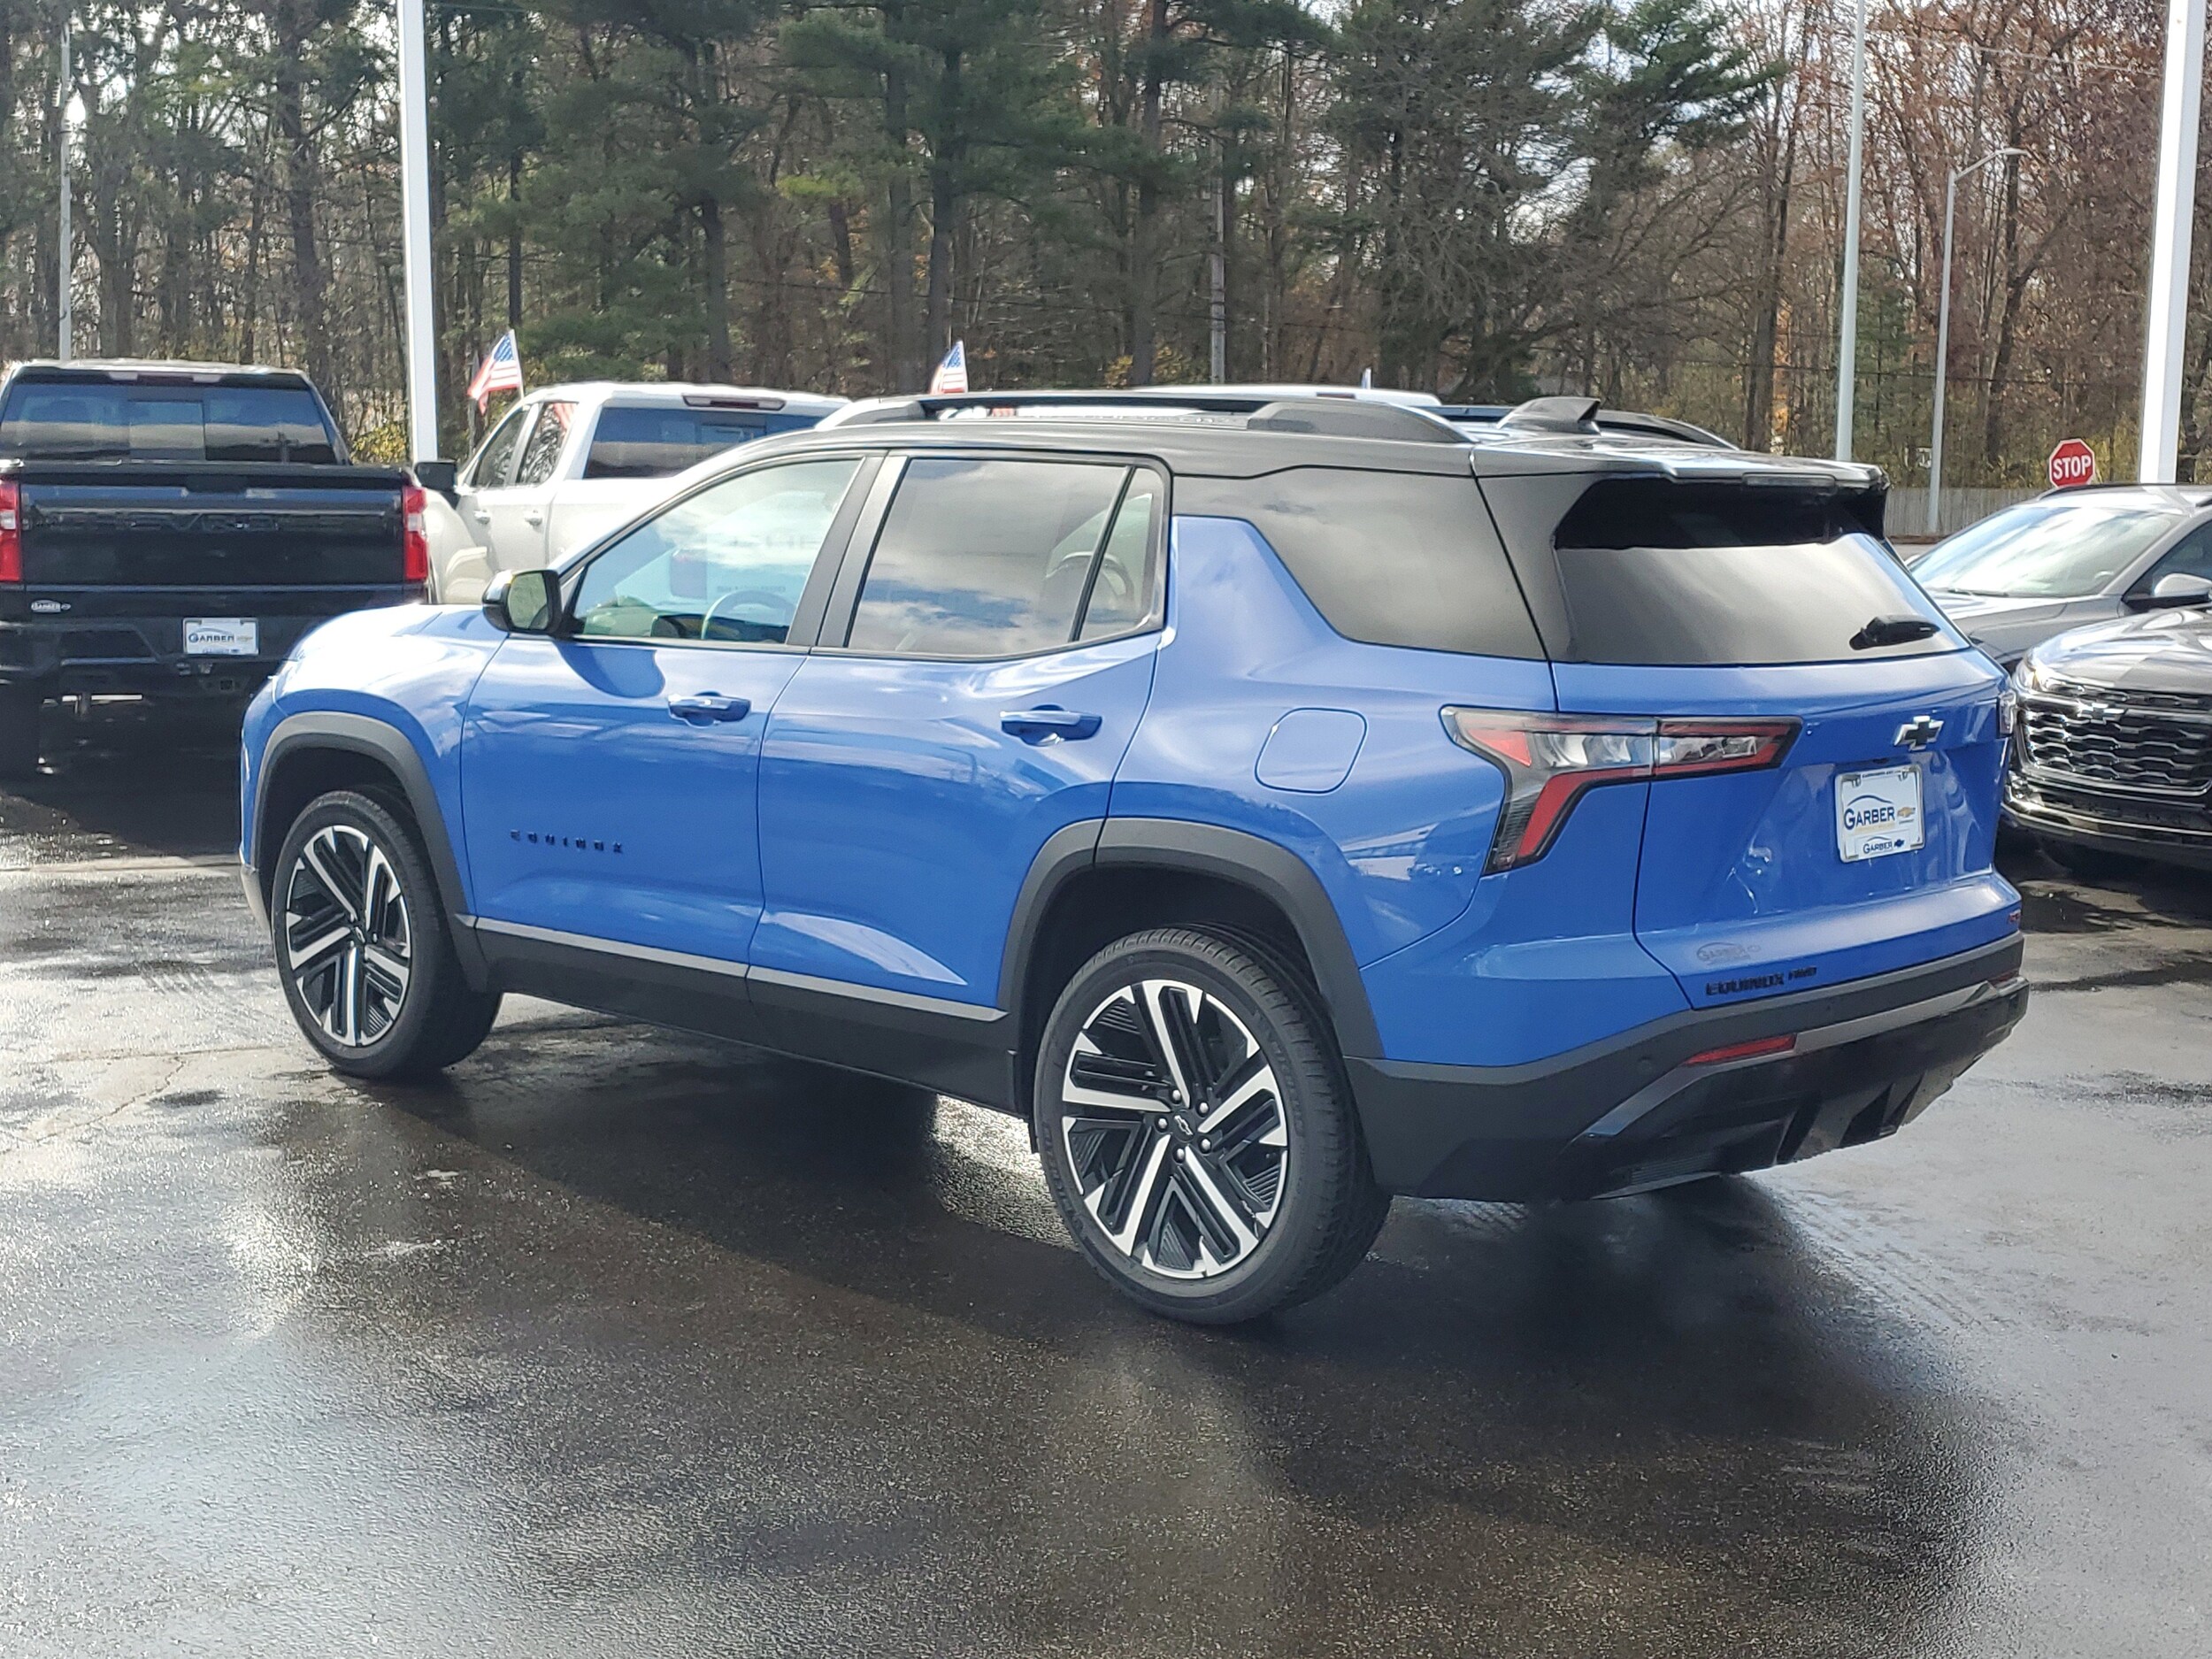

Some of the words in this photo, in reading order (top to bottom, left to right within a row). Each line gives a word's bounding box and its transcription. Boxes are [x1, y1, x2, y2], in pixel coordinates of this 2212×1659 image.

[2053, 455, 2092, 480] STOP
[1844, 806, 1895, 830] GARBER
[1863, 841, 1893, 854] GARBER
